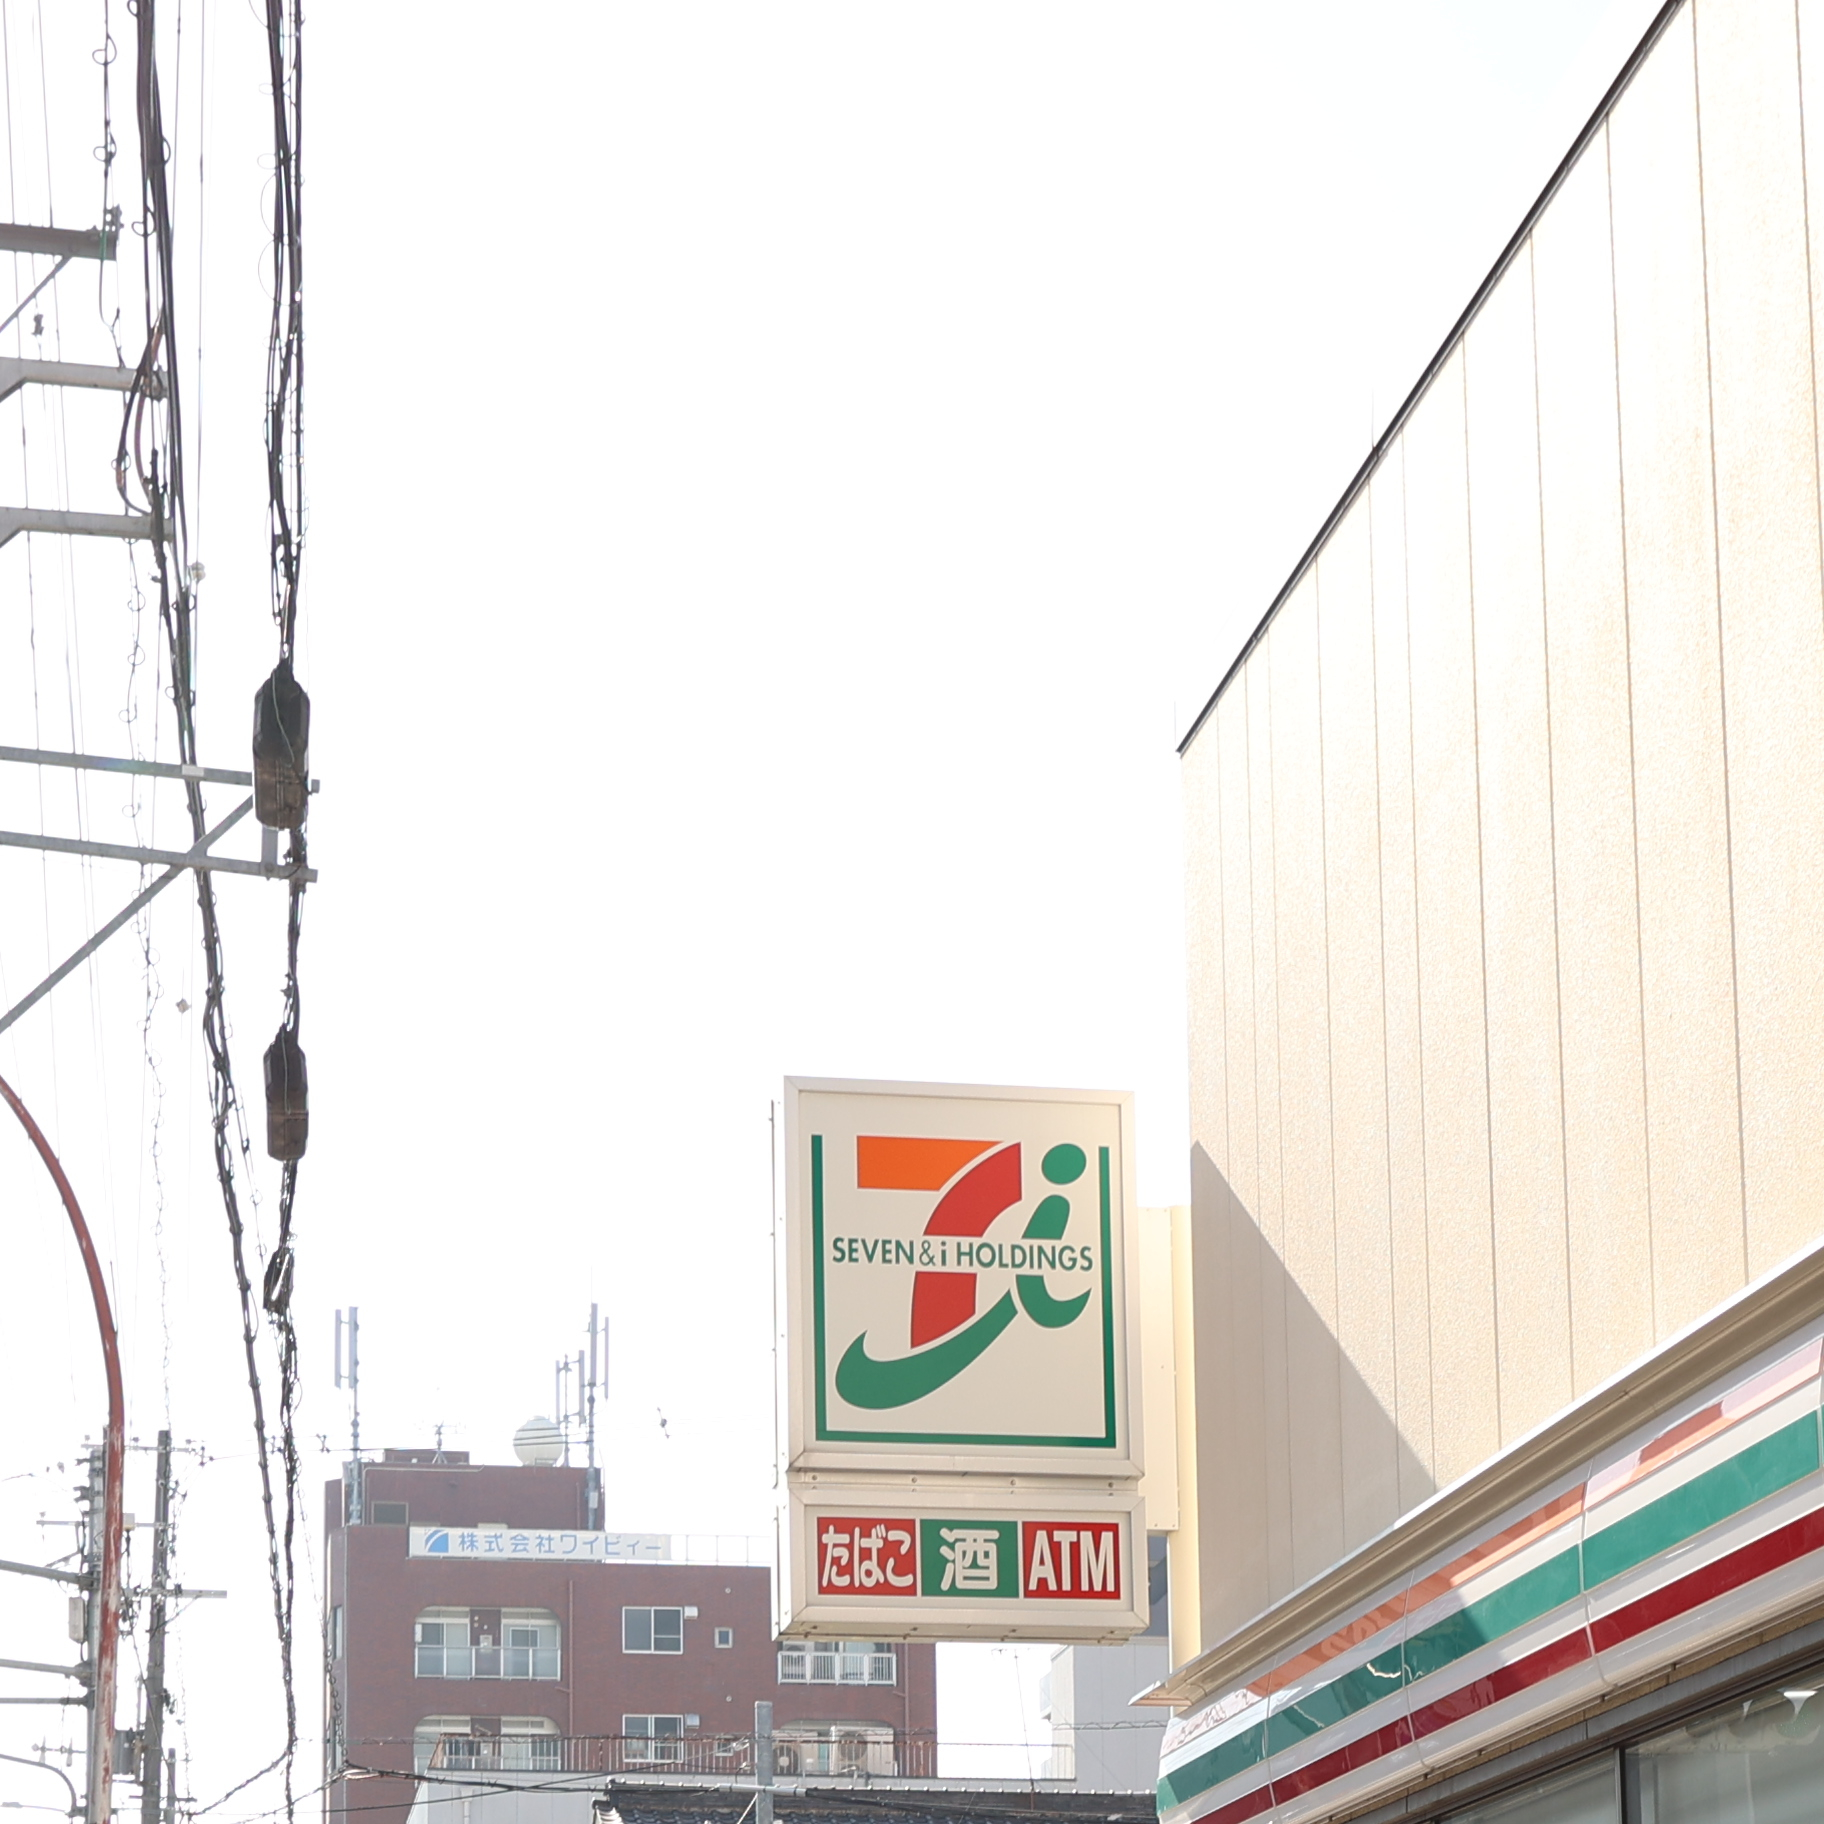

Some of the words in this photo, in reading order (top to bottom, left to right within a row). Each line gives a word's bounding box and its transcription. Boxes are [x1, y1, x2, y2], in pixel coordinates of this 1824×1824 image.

[955, 1241, 1093, 1272] HOLDINGS
[821, 1522, 914, 1588] たばこ
[939, 1527, 1000, 1592] 酒
[1027, 1530, 1116, 1593] ATM
